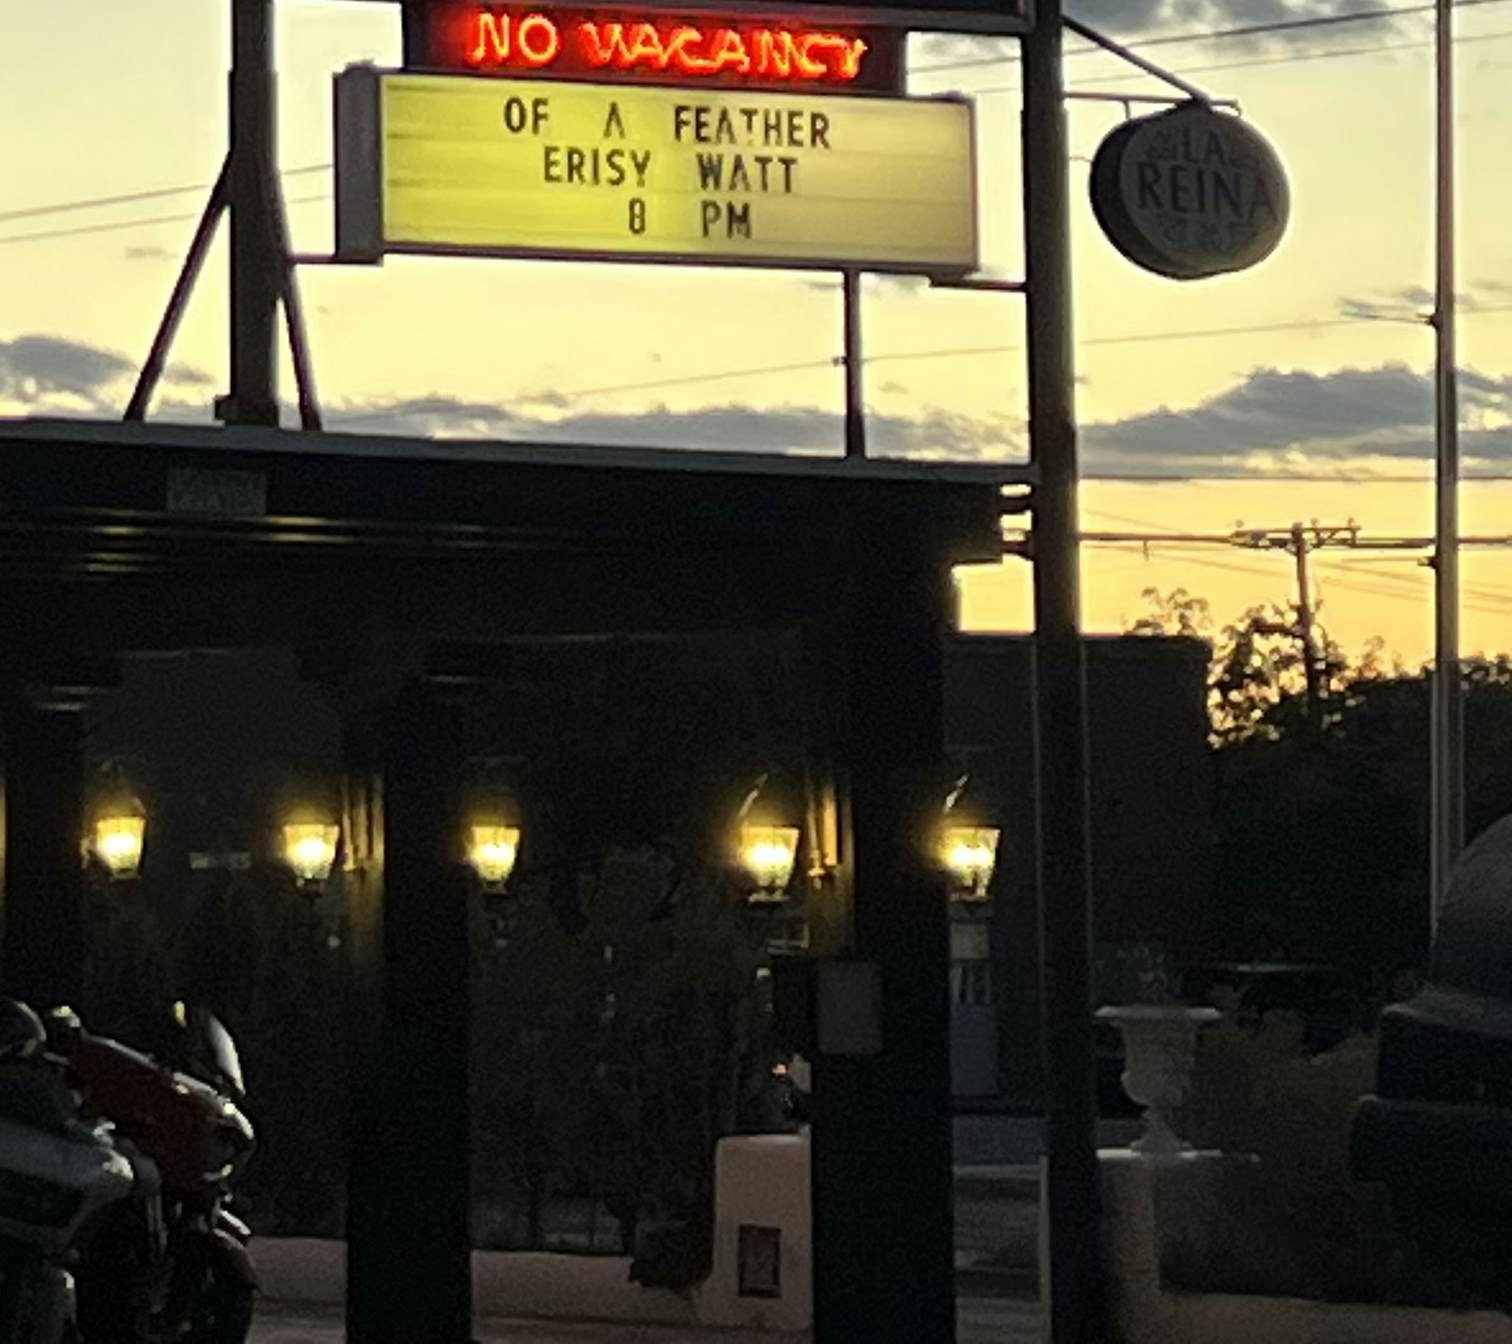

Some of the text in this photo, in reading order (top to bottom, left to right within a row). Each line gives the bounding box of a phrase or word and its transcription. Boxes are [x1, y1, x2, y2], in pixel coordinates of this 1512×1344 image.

[468, 11, 869, 80] NO VACANCY
[503, 97, 831, 150] OF A FEATHER
[543, 145, 799, 194] ERISY WATT
[1138, 161, 1277, 223] REINA
[628, 197, 753, 240] 8 PM
